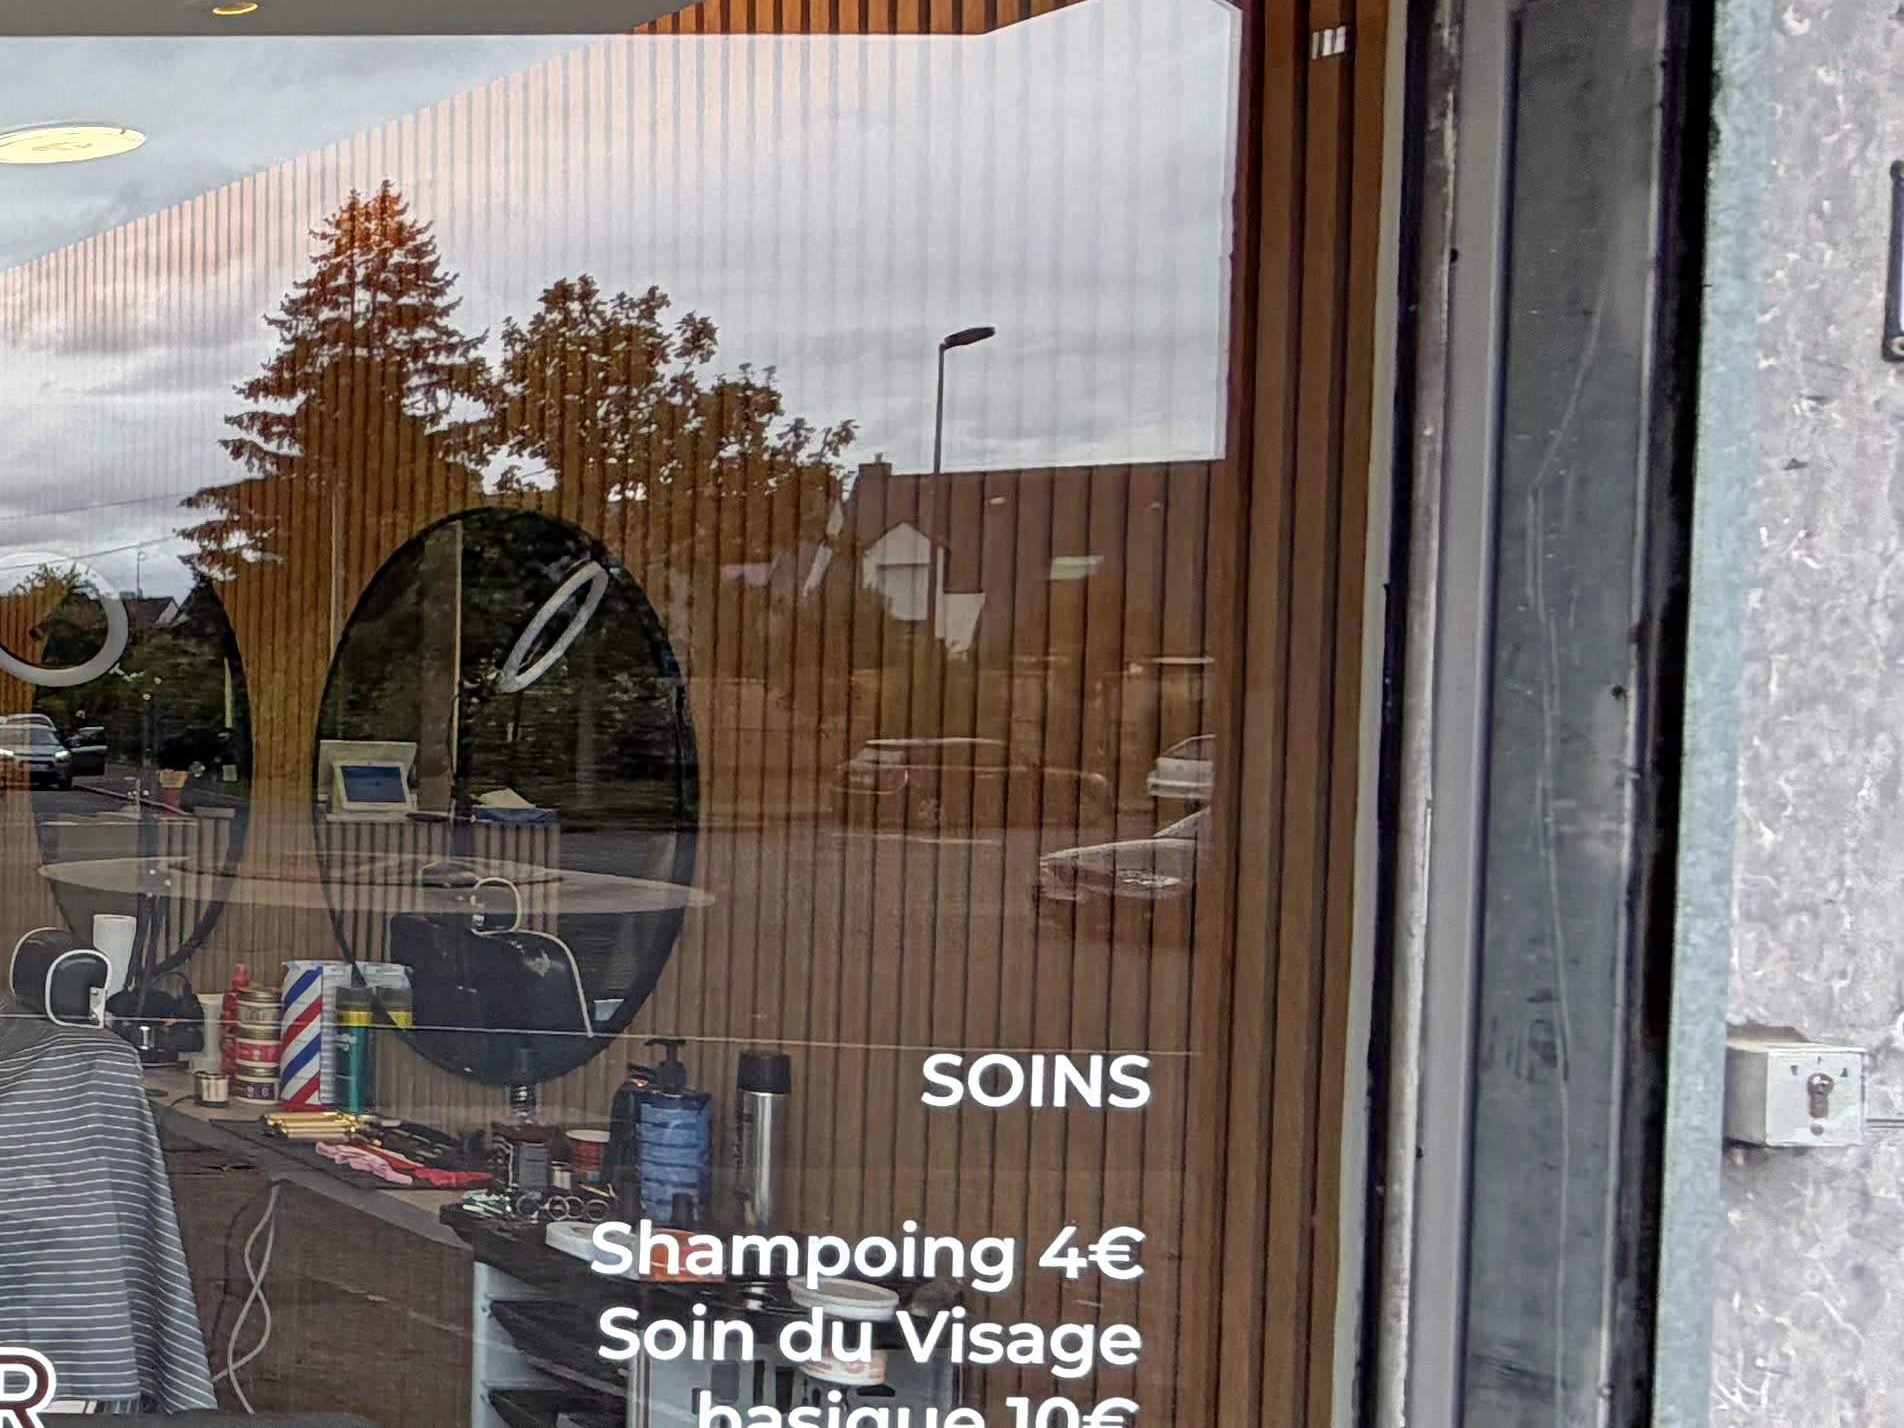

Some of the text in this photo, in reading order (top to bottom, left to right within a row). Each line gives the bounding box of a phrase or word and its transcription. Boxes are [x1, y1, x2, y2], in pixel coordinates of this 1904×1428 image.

[921, 1053, 1151, 1109] SOINS
[591, 1219, 1146, 1293] Shampoing 4€
[598, 1303, 1142, 1379] Soin du Visage
